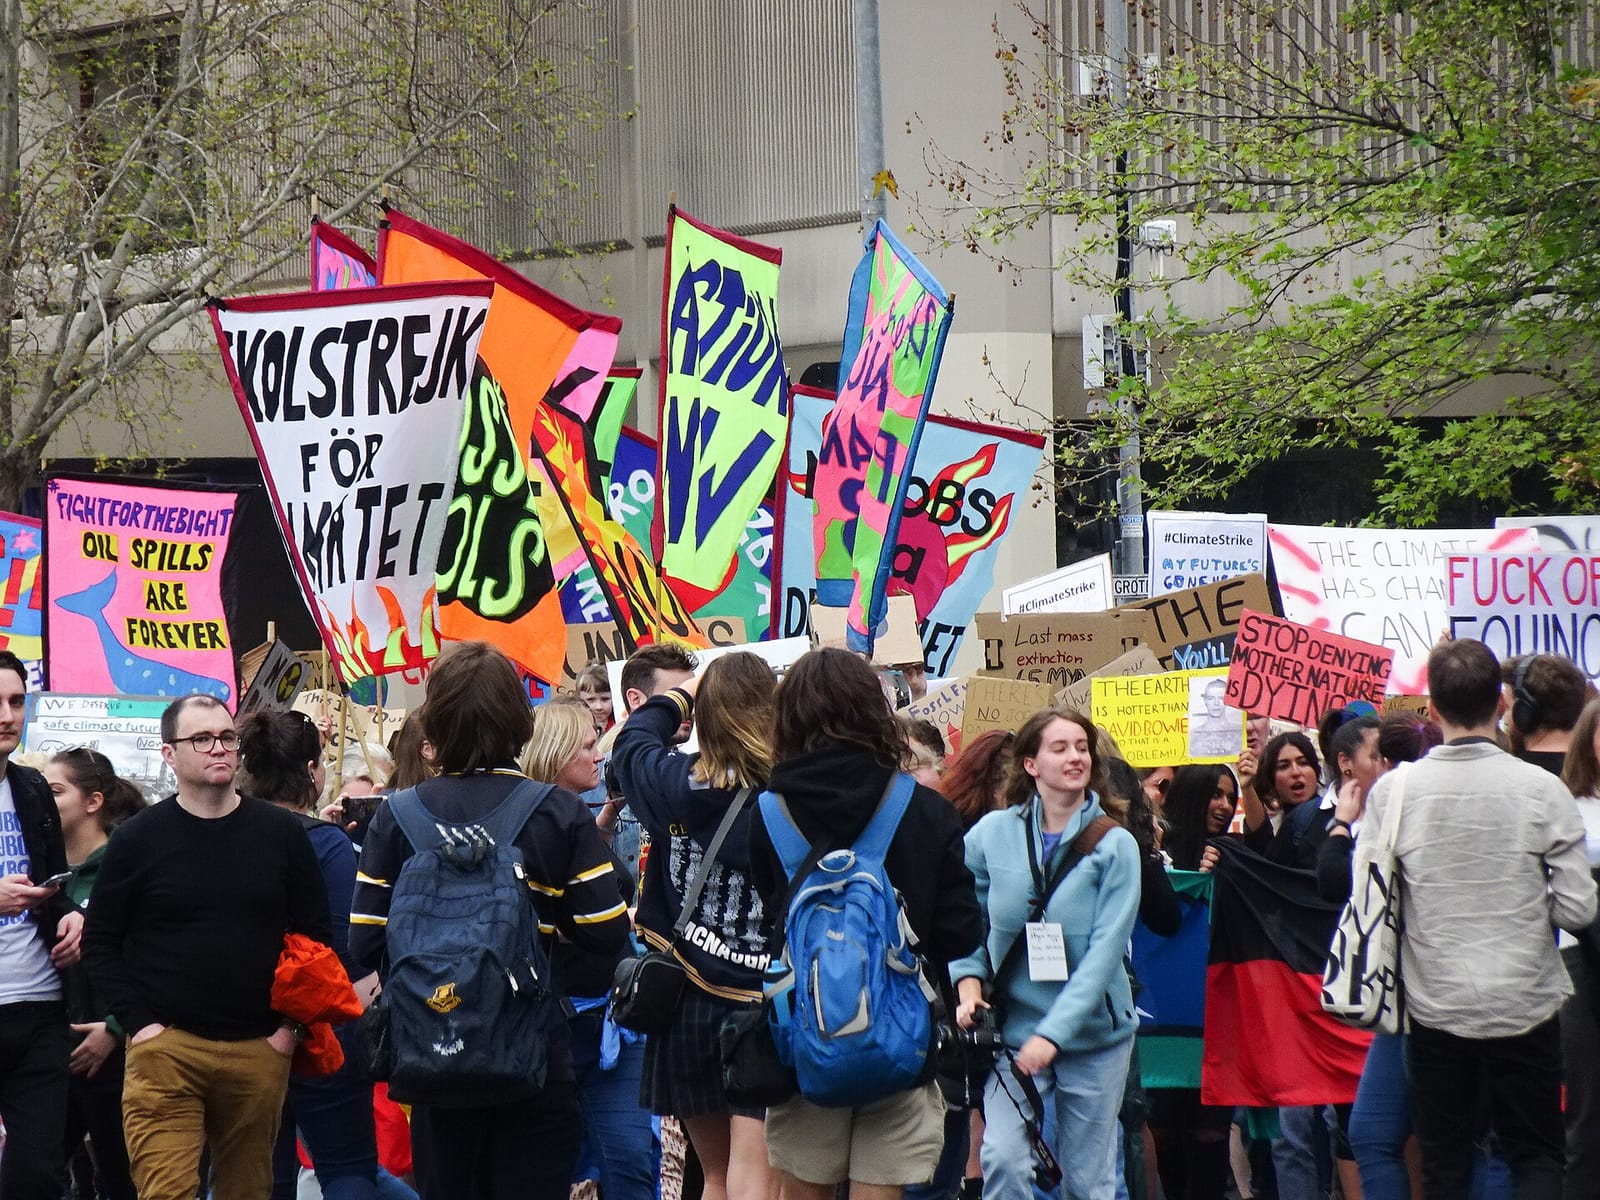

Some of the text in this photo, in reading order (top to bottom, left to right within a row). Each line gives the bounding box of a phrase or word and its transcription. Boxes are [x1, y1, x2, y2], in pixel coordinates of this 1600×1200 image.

[83, 531, 213, 571] OIL SPILLS
[1164, 532, 1254, 546] #ClimateStrike
[1162, 558, 1259, 571] MY FUTURE'S
[1308, 540, 1364, 567] THE
[1321, 577, 1377, 600] HAS
[1448, 556, 1553, 606] FUCK
[146, 580, 187, 612] ARE
[1018, 580, 1096, 614] #ClimateStrike
[1139, 580, 1245, 643] THE
[126, 618, 227, 649] FOREVER
[1014, 625, 1094, 647] Last mass
[1016, 649, 1084, 667] extinction
[1174, 641, 1230, 669] YOU'LL
[1241, 615, 1392, 680] STOP DENYING
[1232, 643, 1387, 705] MOTHER NATURE
[1226, 679, 1240, 698] IS
[977, 706, 1000, 721] NO
[1096, 702, 1189, 717] IS HOTTER THAN
[43, 719, 161, 734] safe climate futur
[1145, 717, 1188, 736] BOWIE
